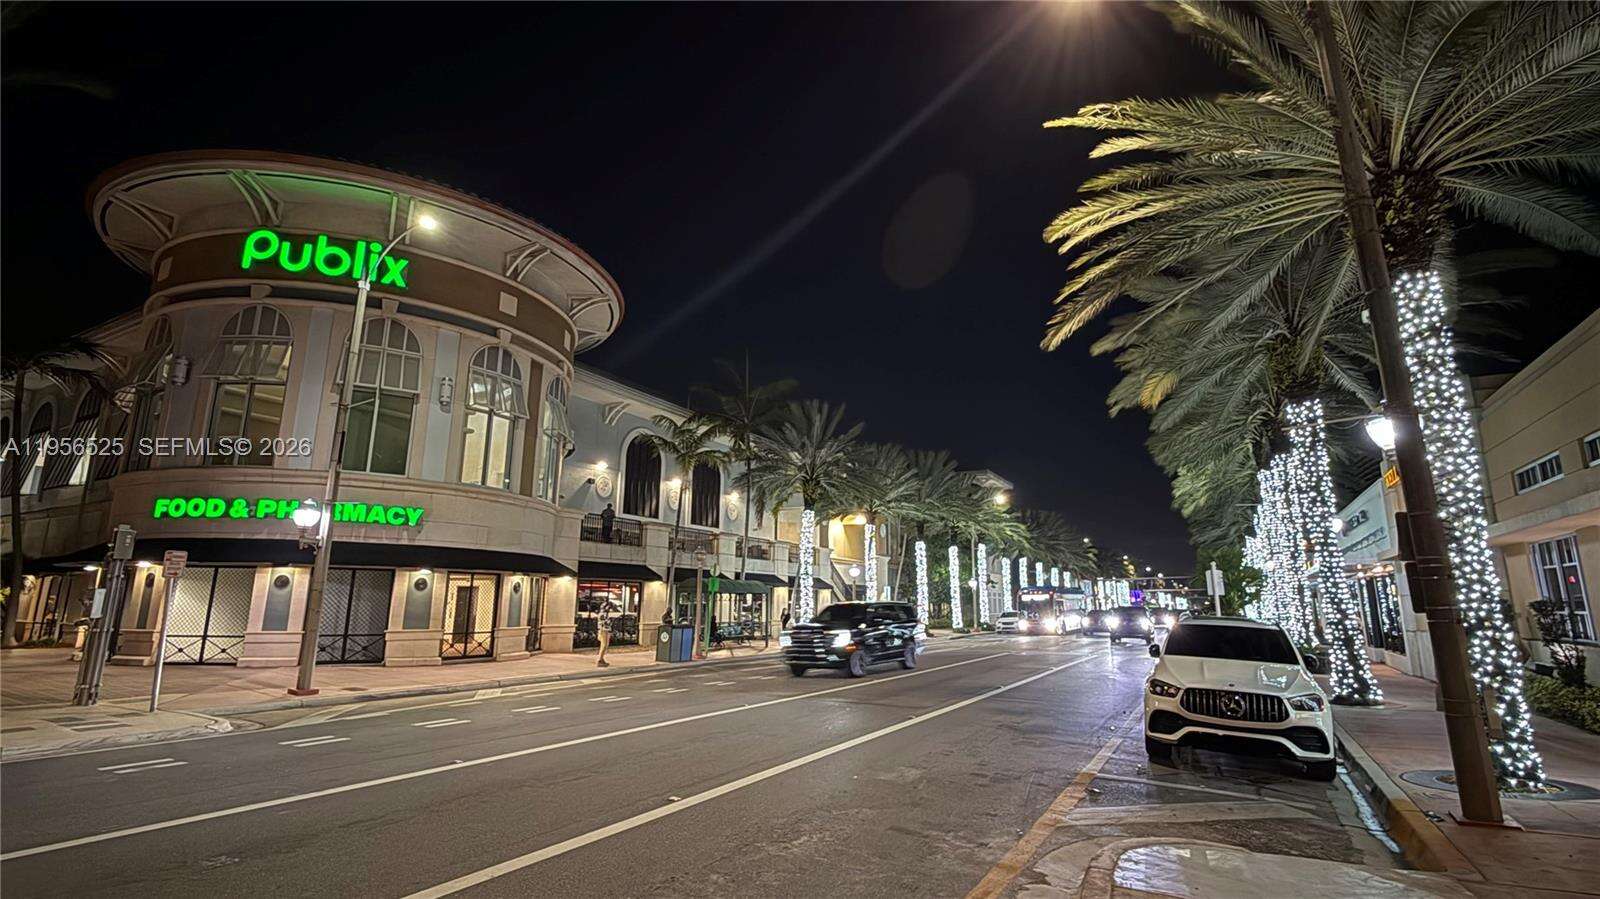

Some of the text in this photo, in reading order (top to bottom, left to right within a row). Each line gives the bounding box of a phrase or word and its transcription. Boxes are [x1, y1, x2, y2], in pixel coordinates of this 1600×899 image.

[241, 229, 408, 288] Publix
[154, 498, 225, 518] FOOD
[229, 499, 249, 518] &
